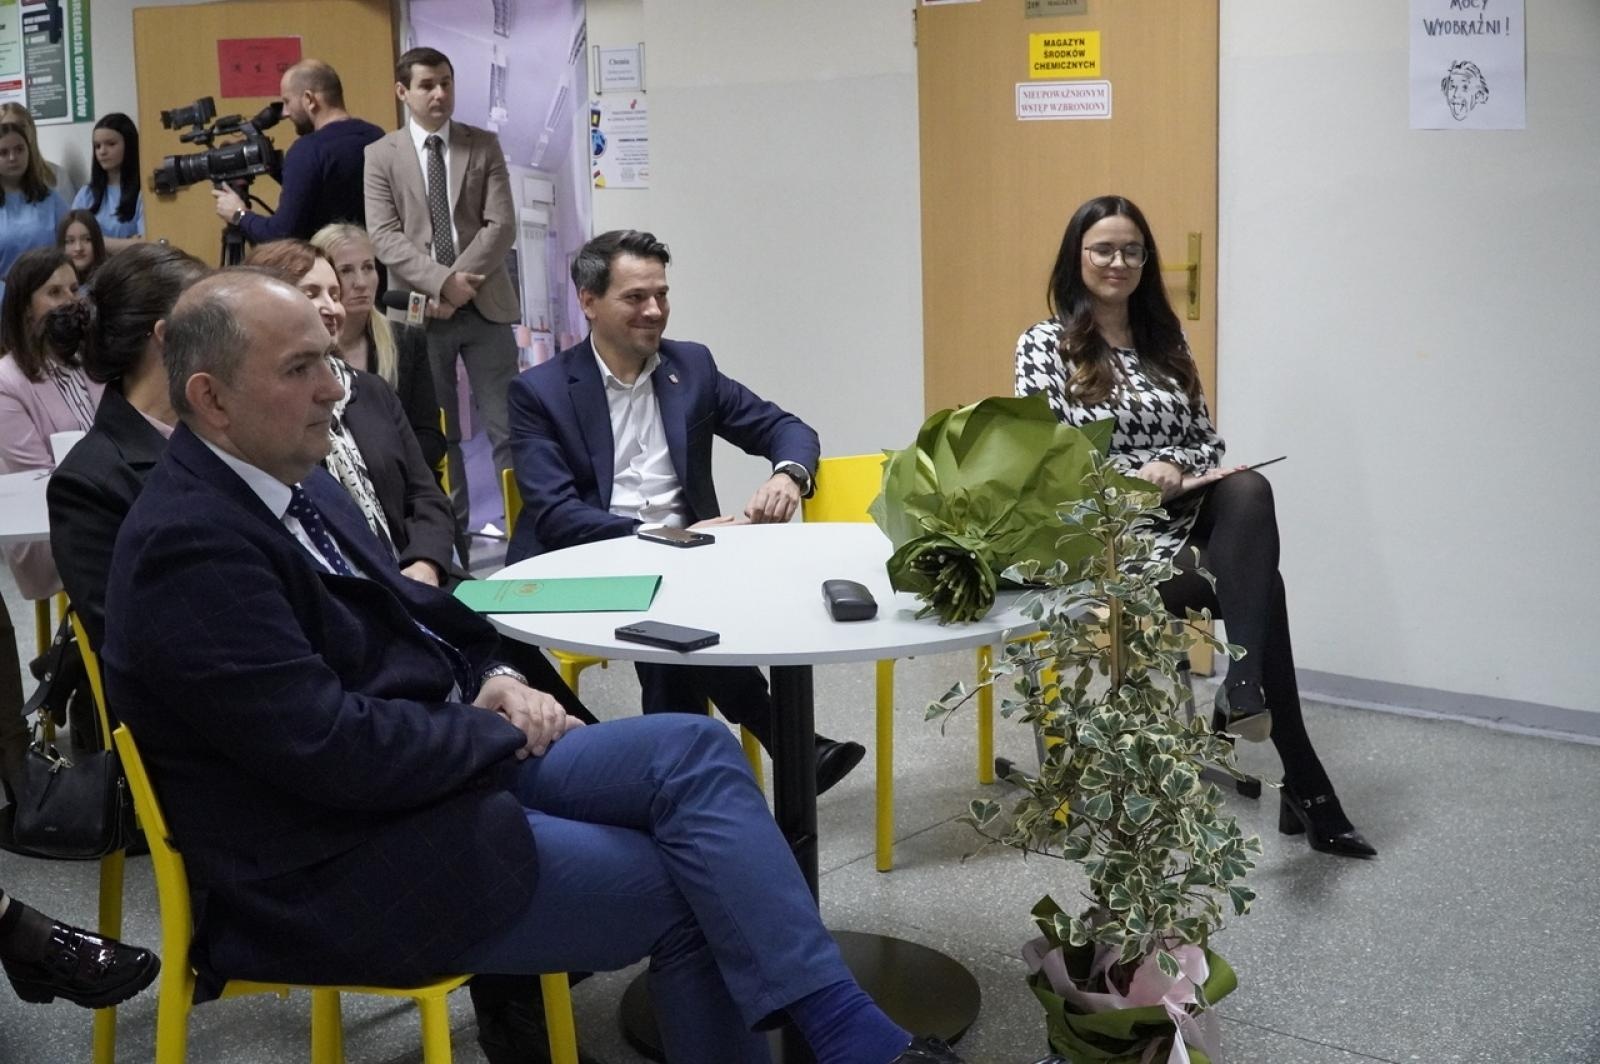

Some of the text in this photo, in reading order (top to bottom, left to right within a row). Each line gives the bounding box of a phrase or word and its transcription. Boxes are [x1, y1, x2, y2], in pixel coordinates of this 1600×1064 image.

[1043, 38, 1085, 47] MAGAZYN
[1043, 48, 1086, 59] ŚRODKÓW
[1034, 61, 1096, 71] CHEMICZNYCH
[1023, 88, 1105, 99] NIEUPOWAŻNIONYM
[1021, 102, 1105, 114] WSTĘP WZBRONIONY
